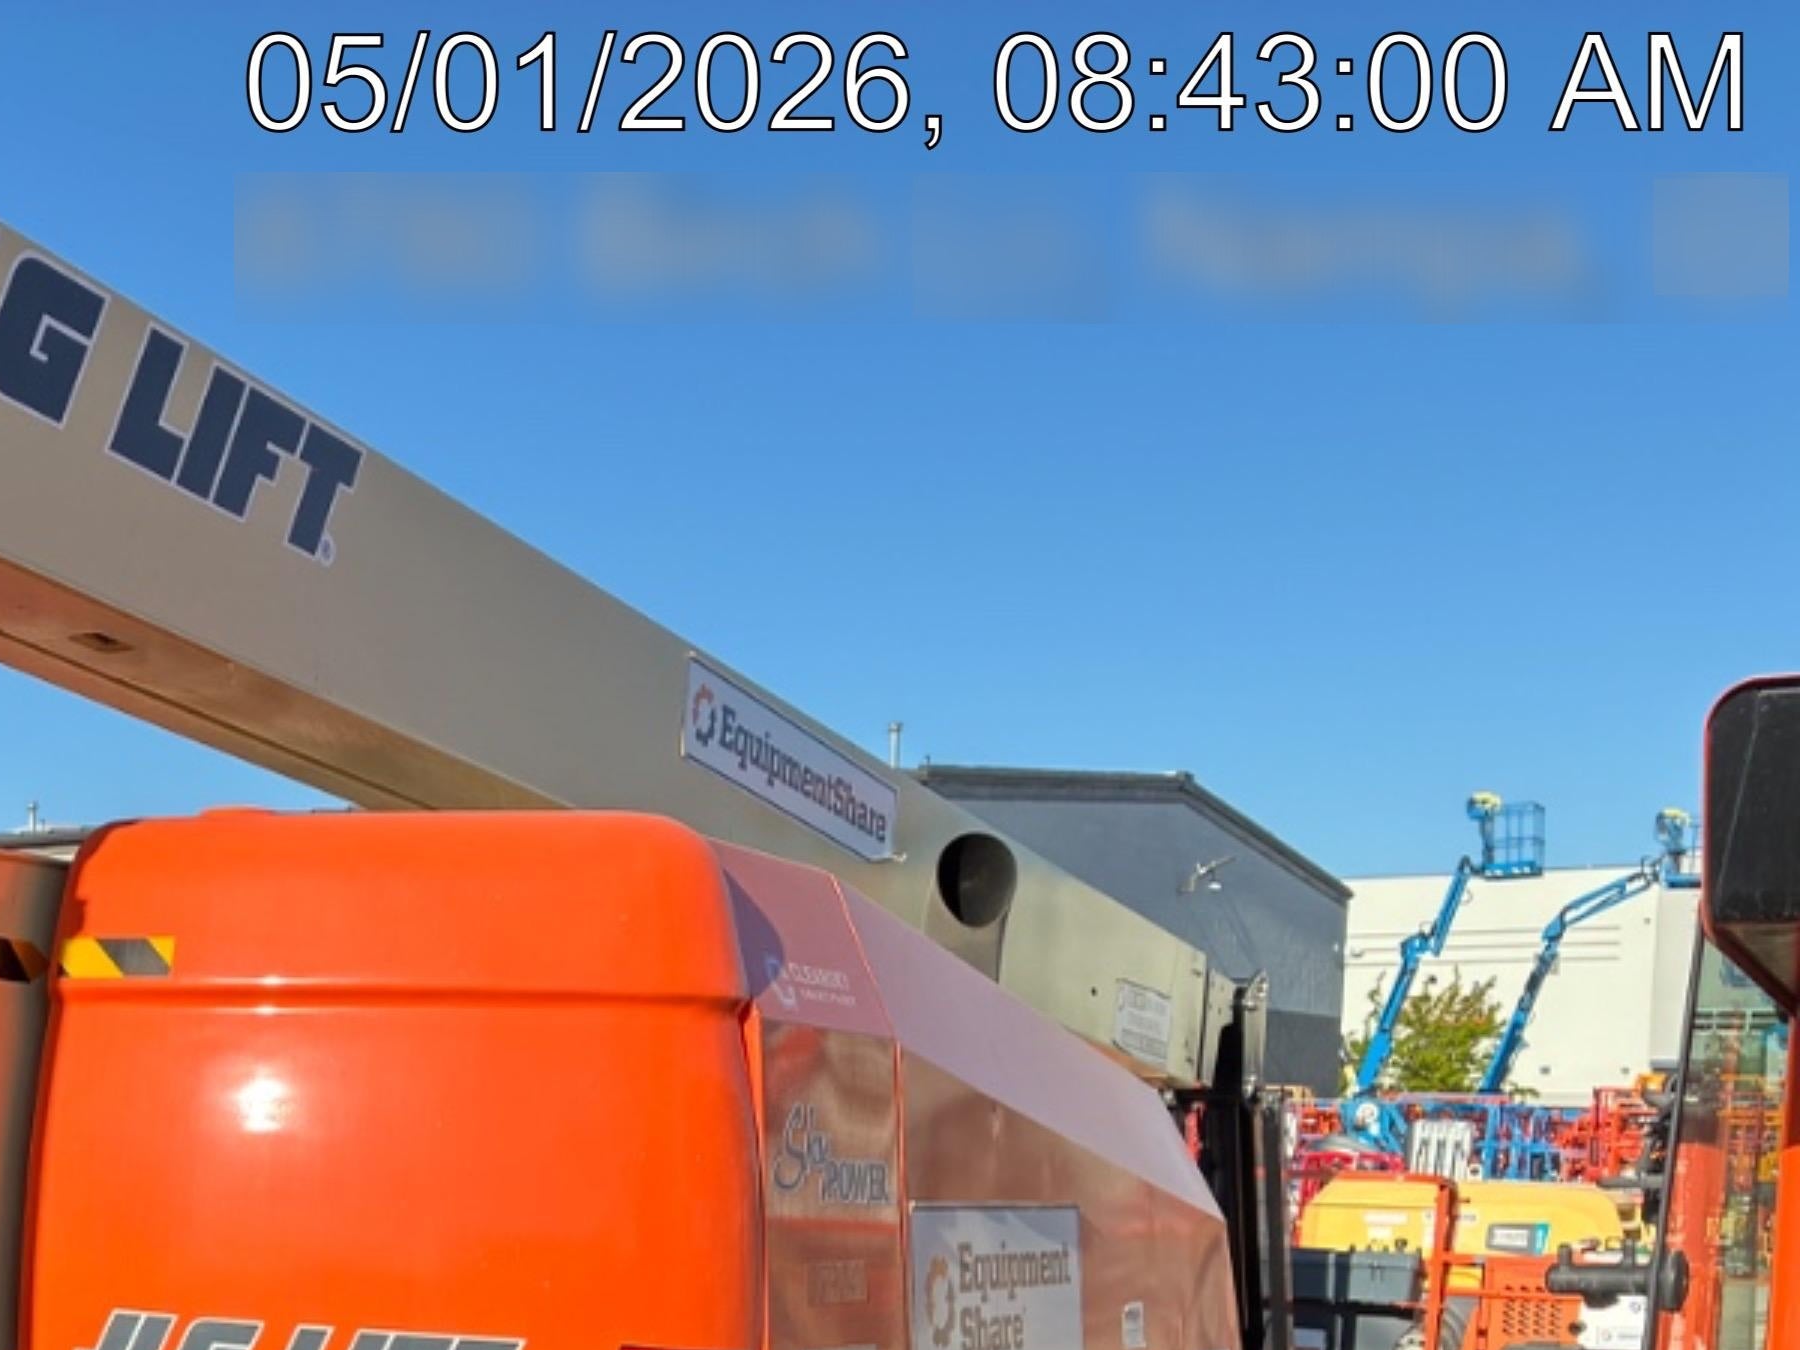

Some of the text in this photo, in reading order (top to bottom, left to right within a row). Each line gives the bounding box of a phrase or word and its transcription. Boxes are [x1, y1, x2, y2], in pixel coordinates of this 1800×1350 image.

[106, 322, 367, 560] LIFT
[718, 703, 887, 844] EquipmentShare
[957, 1239, 1072, 1302] Equipment
